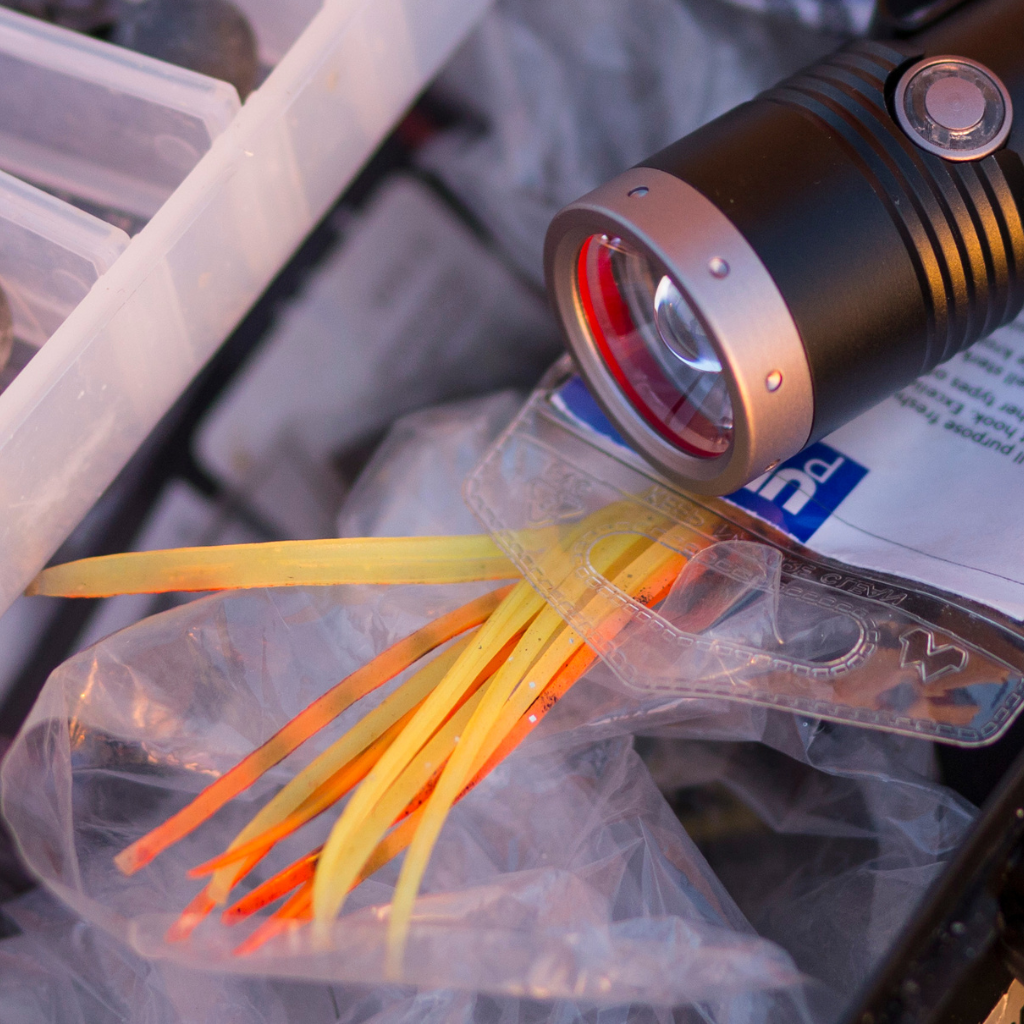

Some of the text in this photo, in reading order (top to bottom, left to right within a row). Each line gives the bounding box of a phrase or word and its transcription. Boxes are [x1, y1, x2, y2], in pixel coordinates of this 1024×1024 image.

[894, 391, 940, 425] fresh
[950, 376, 996, 407] types
[943, 420, 1016, 455] purpose
